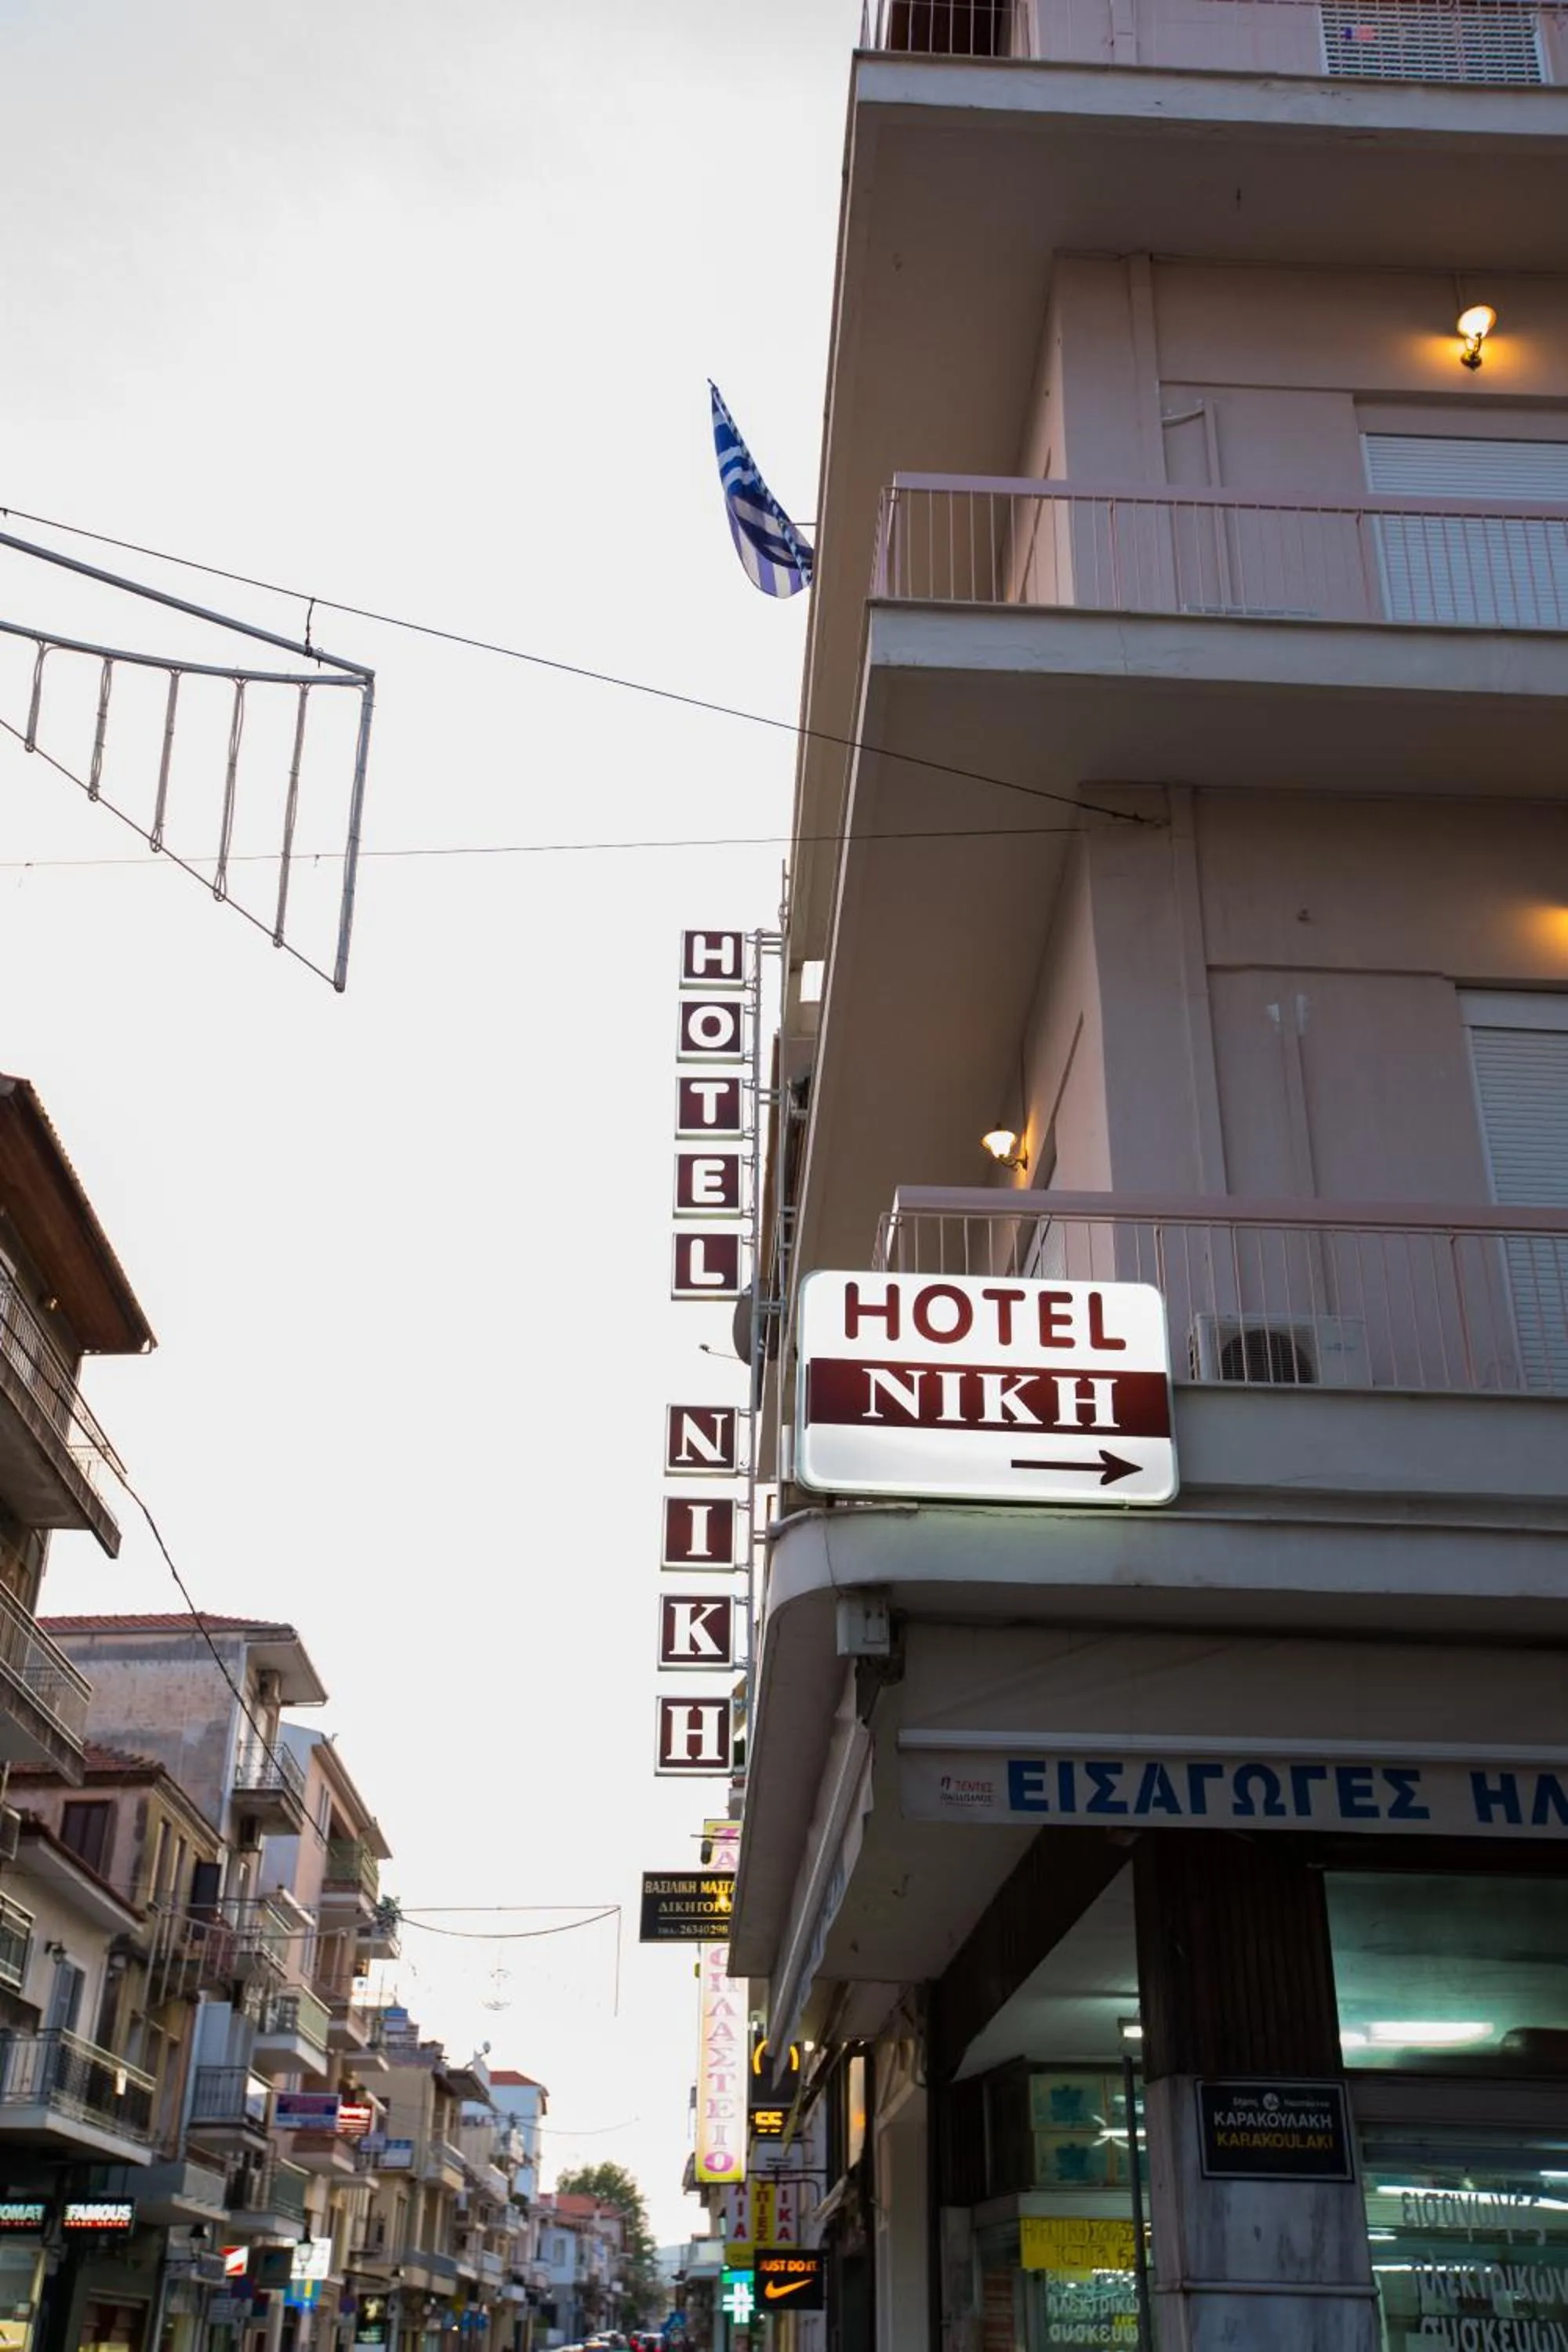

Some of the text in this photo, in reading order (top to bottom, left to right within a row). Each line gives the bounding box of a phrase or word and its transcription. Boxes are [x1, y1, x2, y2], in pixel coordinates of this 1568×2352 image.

[688, 935, 735, 1286] HOTEL
[844, 1282, 1127, 1351] HOTEL
[862, 1368, 1120, 1428] ΝΙΚΗ
[665, 1412, 728, 1761] ΝΙΚΗ
[1007, 1759, 1431, 1820] ΕΙΣΑΓΩΓΕΣ
[644, 1880, 697, 1894] ΒΑΣΙΛΙΚΗ
[1213, 2110, 1334, 2129] ΚΑΡΑΚΟΥΛΑΚΗ
[1216, 2130, 1334, 2149] KARAKOULAKI
[759, 2259, 786, 2272] JUST
[787, 2259, 805, 2272] DO
